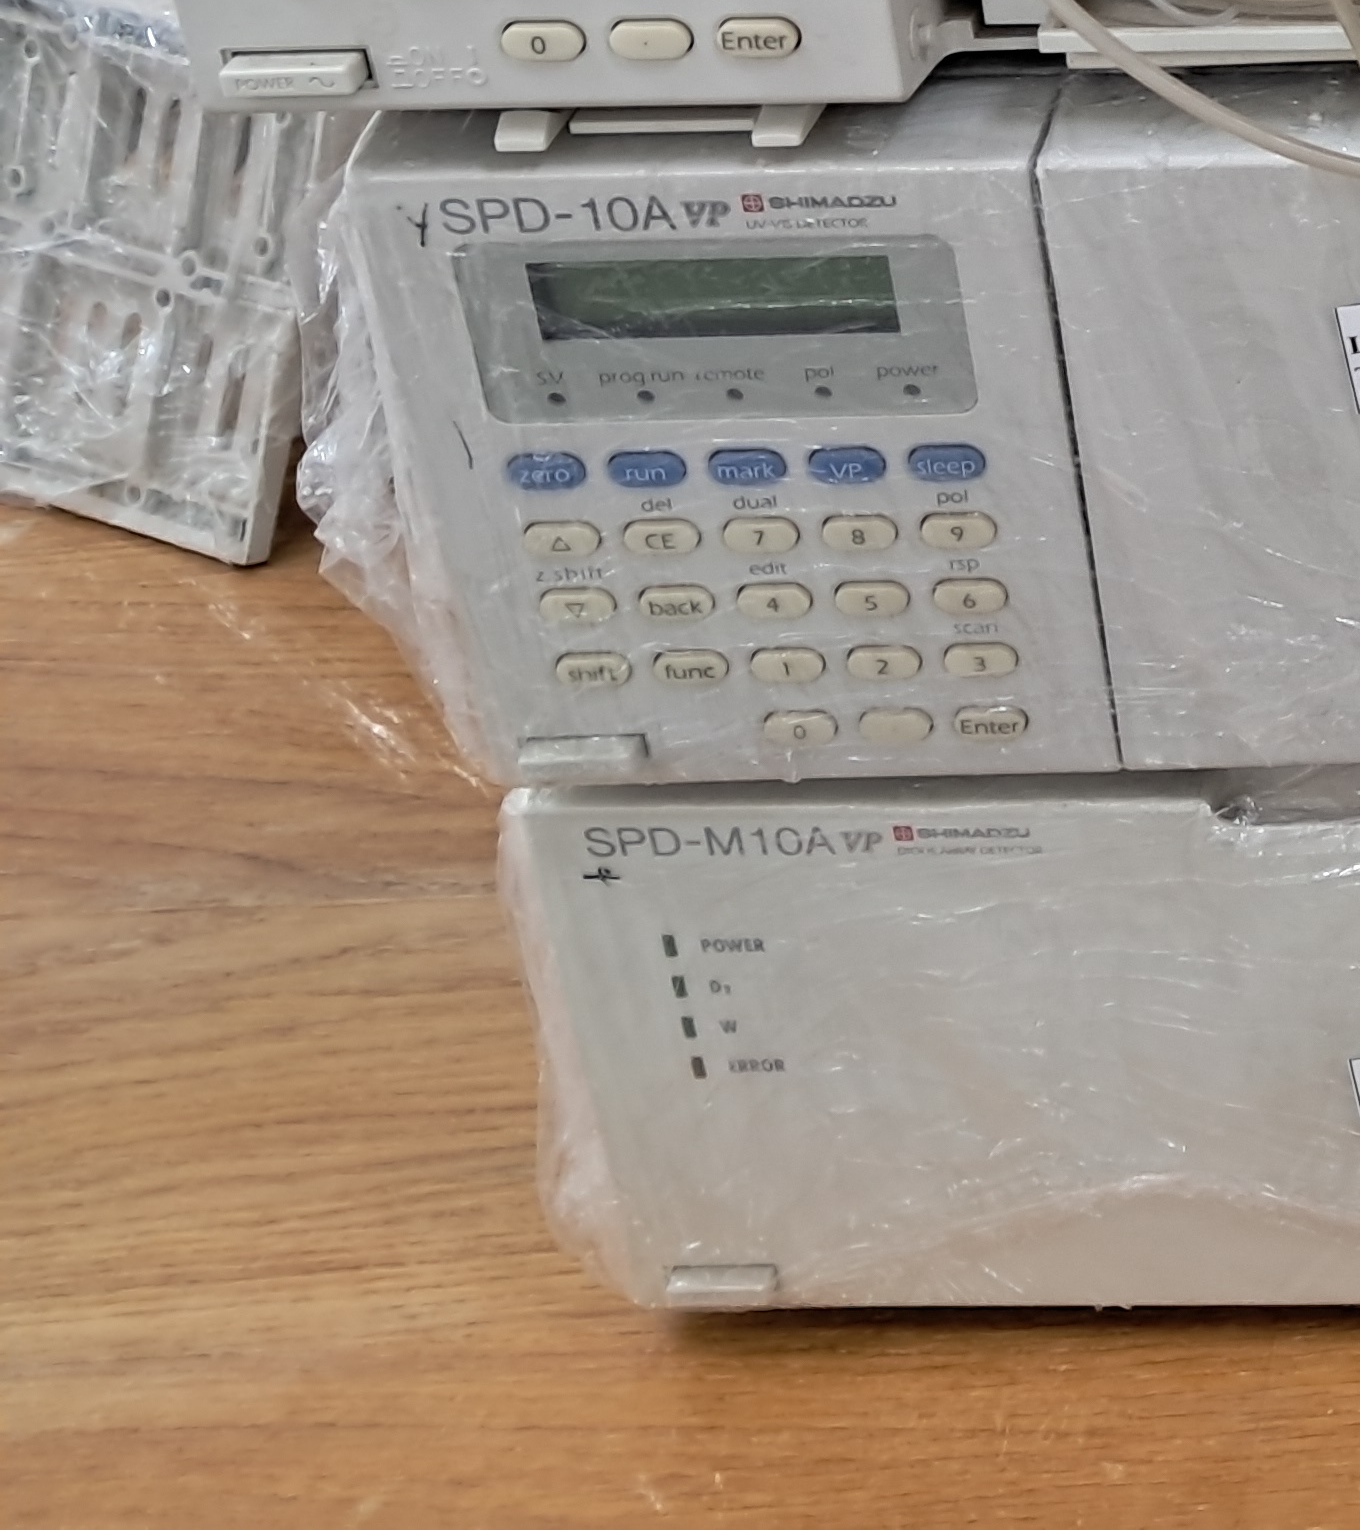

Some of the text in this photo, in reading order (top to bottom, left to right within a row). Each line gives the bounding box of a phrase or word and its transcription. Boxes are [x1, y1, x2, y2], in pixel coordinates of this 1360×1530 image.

[530, 30, 788, 56] 0 Enter
[234, 76, 295, 91] POWER
[768, 195, 897, 210] SHIMADZU
[440, 195, 732, 235] SPD-10A VP
[876, 363, 939, 381] power
[624, 457, 976, 482] run mark sleep
[641, 488, 969, 513] del dual pol
[645, 526, 964, 550] CE 7 8 9
[749, 560, 788, 576] edit
[648, 592, 977, 618] back 4 5 6
[662, 654, 987, 681] func 3
[959, 717, 1020, 736] Enter
[582, 826, 883, 858] SPD-M10A VP
[916, 827, 1031, 839] SHIMADZU
[701, 939, 765, 953] POWER
[719, 1019, 738, 1034] W
[728, 1059, 786, 1073] ERROR
